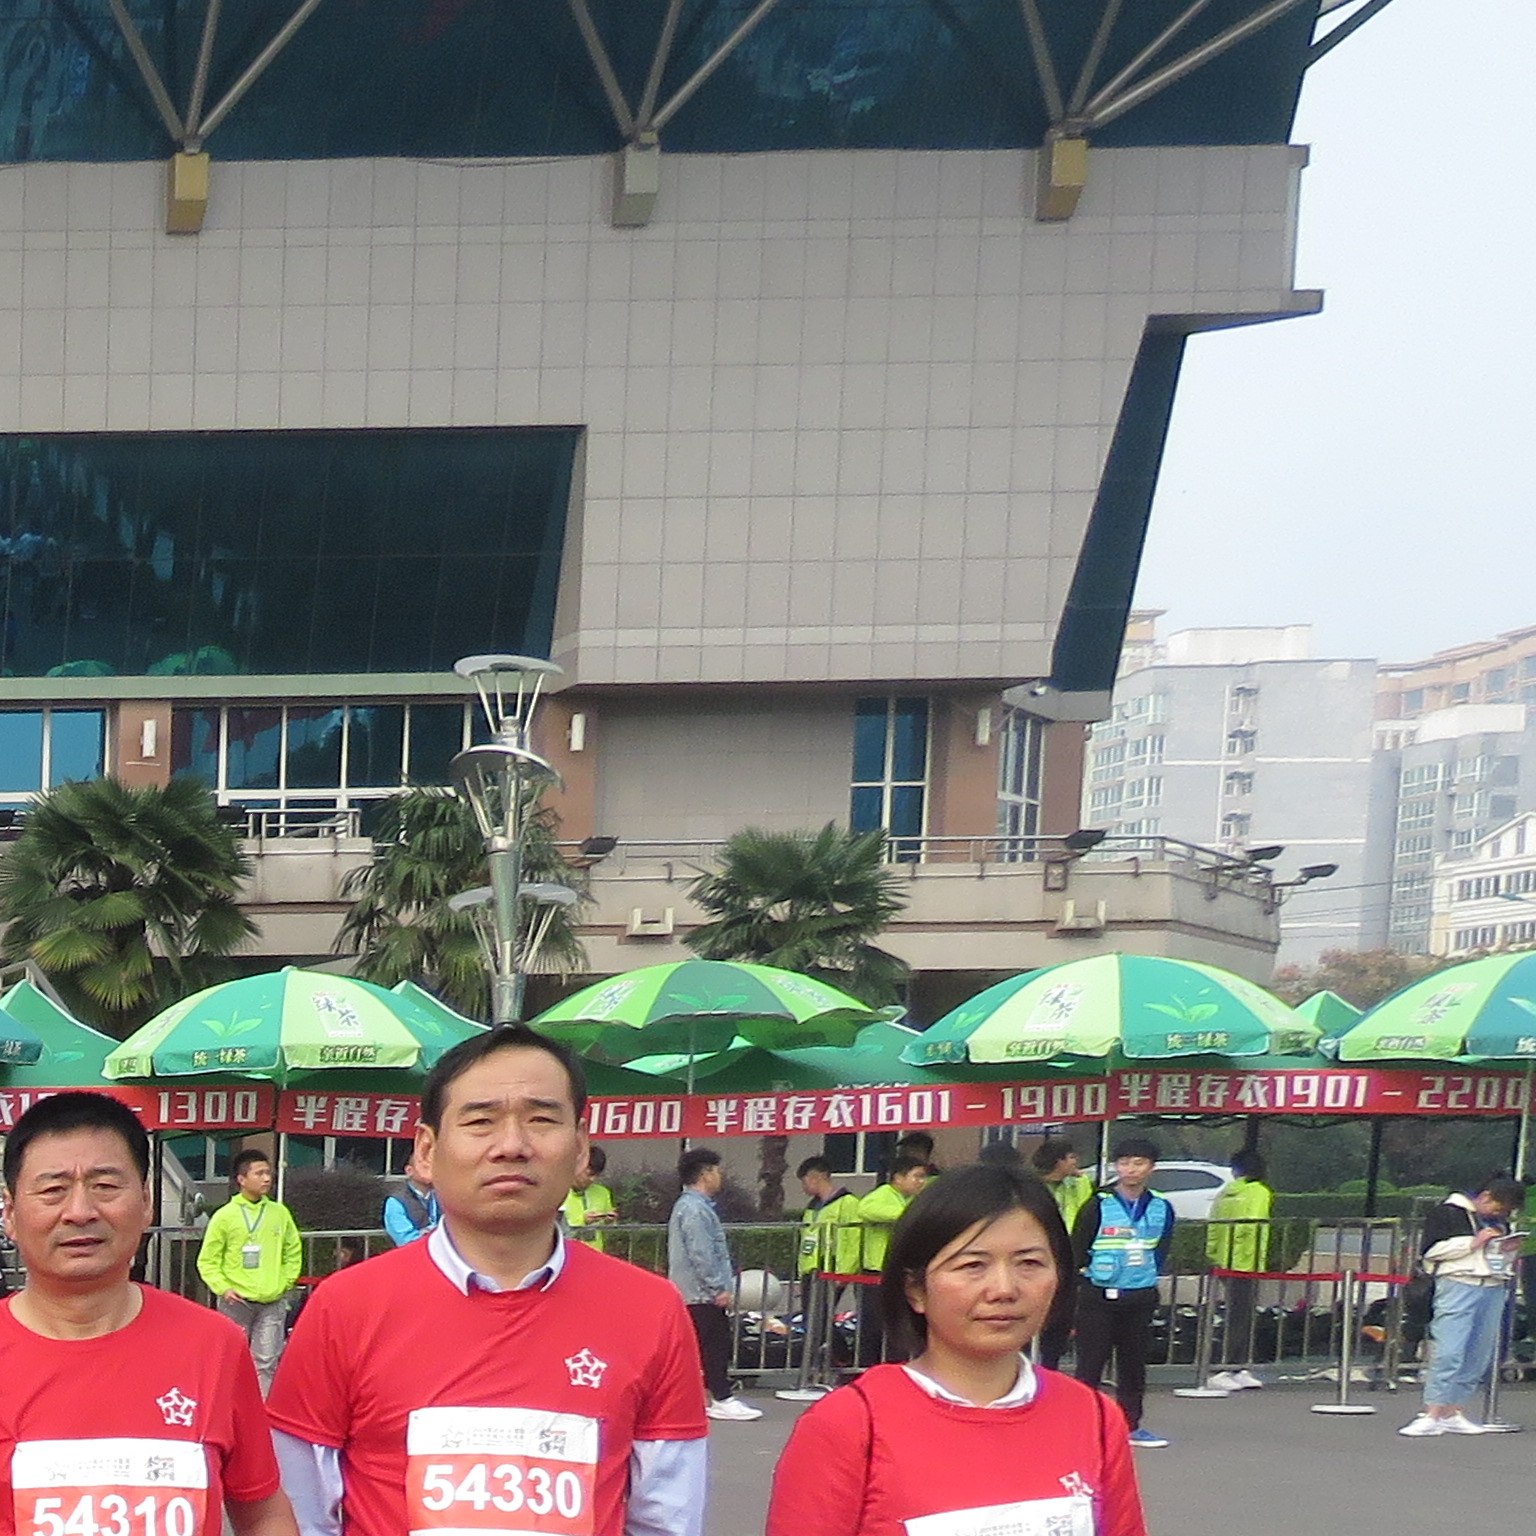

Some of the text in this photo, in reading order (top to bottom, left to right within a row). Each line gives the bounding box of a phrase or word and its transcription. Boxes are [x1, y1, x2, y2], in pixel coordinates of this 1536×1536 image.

[157, 1090, 258, 1123] 1300
[705, 1089, 951, 1134] 半程存衣1601
[1001, 1082, 1108, 1120] 1900
[1119, 1073, 1369, 1109] 半程存衣1901
[293, 1095, 423, 1133] 半程存
[589, 1100, 682, 1135] 1600
[422, 1463, 583, 1519] 54330
